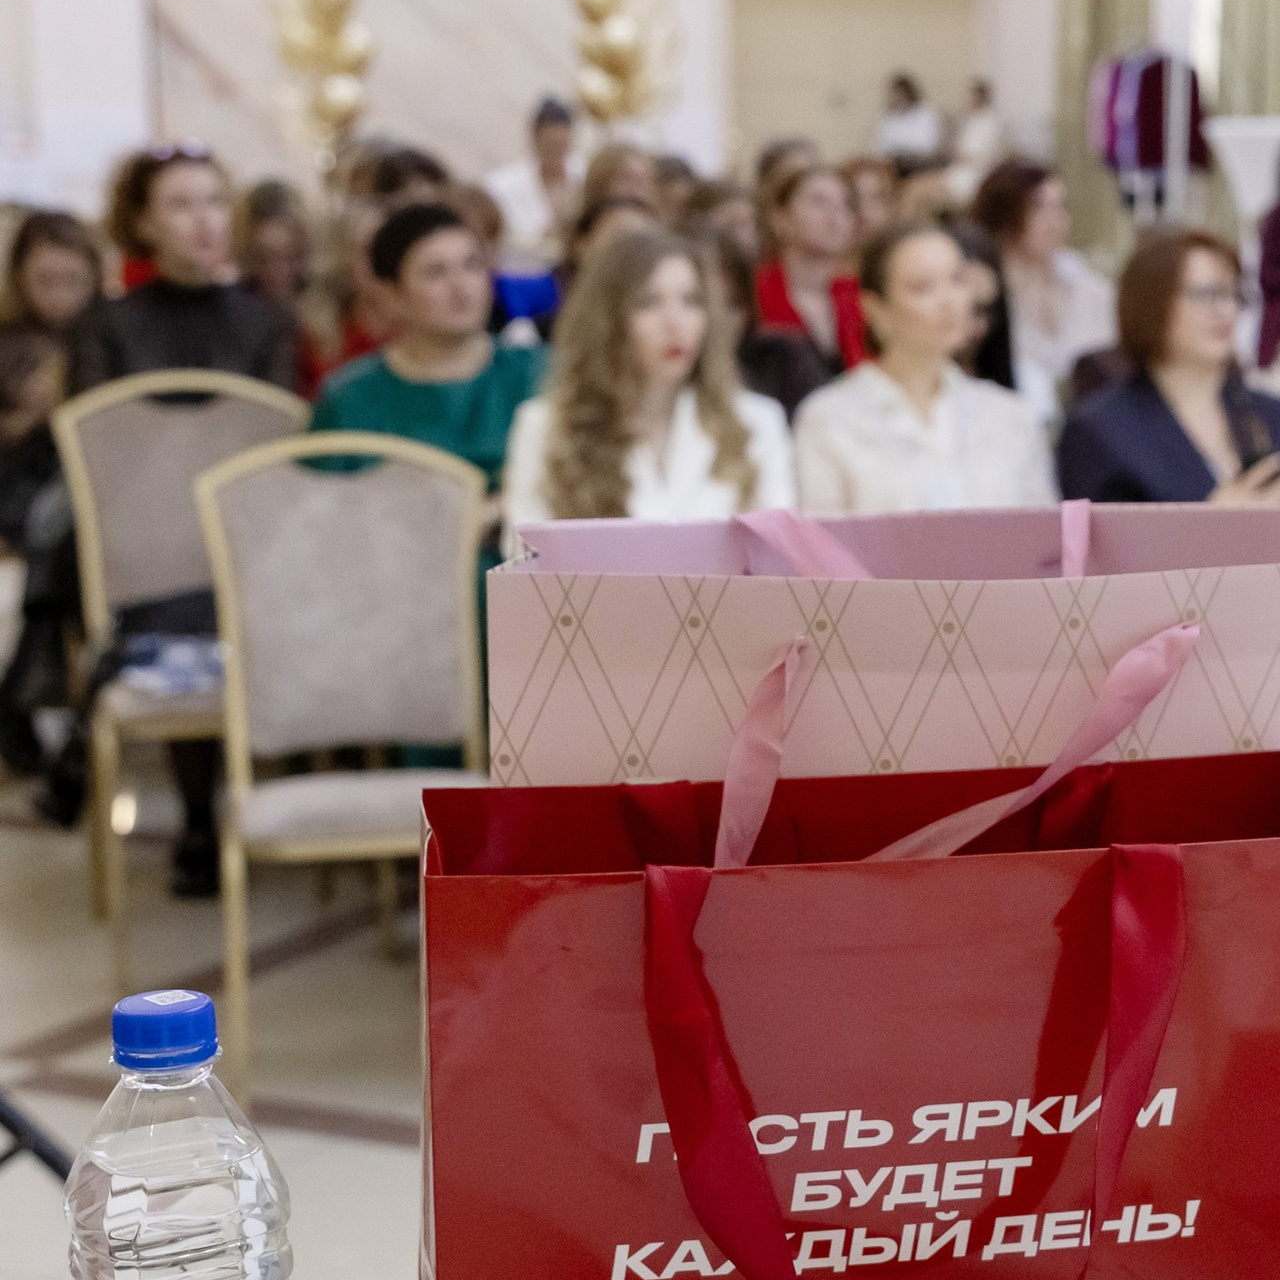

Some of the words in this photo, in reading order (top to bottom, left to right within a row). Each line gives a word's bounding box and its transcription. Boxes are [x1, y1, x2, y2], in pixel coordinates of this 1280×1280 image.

[636, 1109, 894, 1164] ПСТЬ
[790, 1156, 1034, 1212] БУДЕТ
[981, 1199, 1201, 1261] ДЕНЬ!
